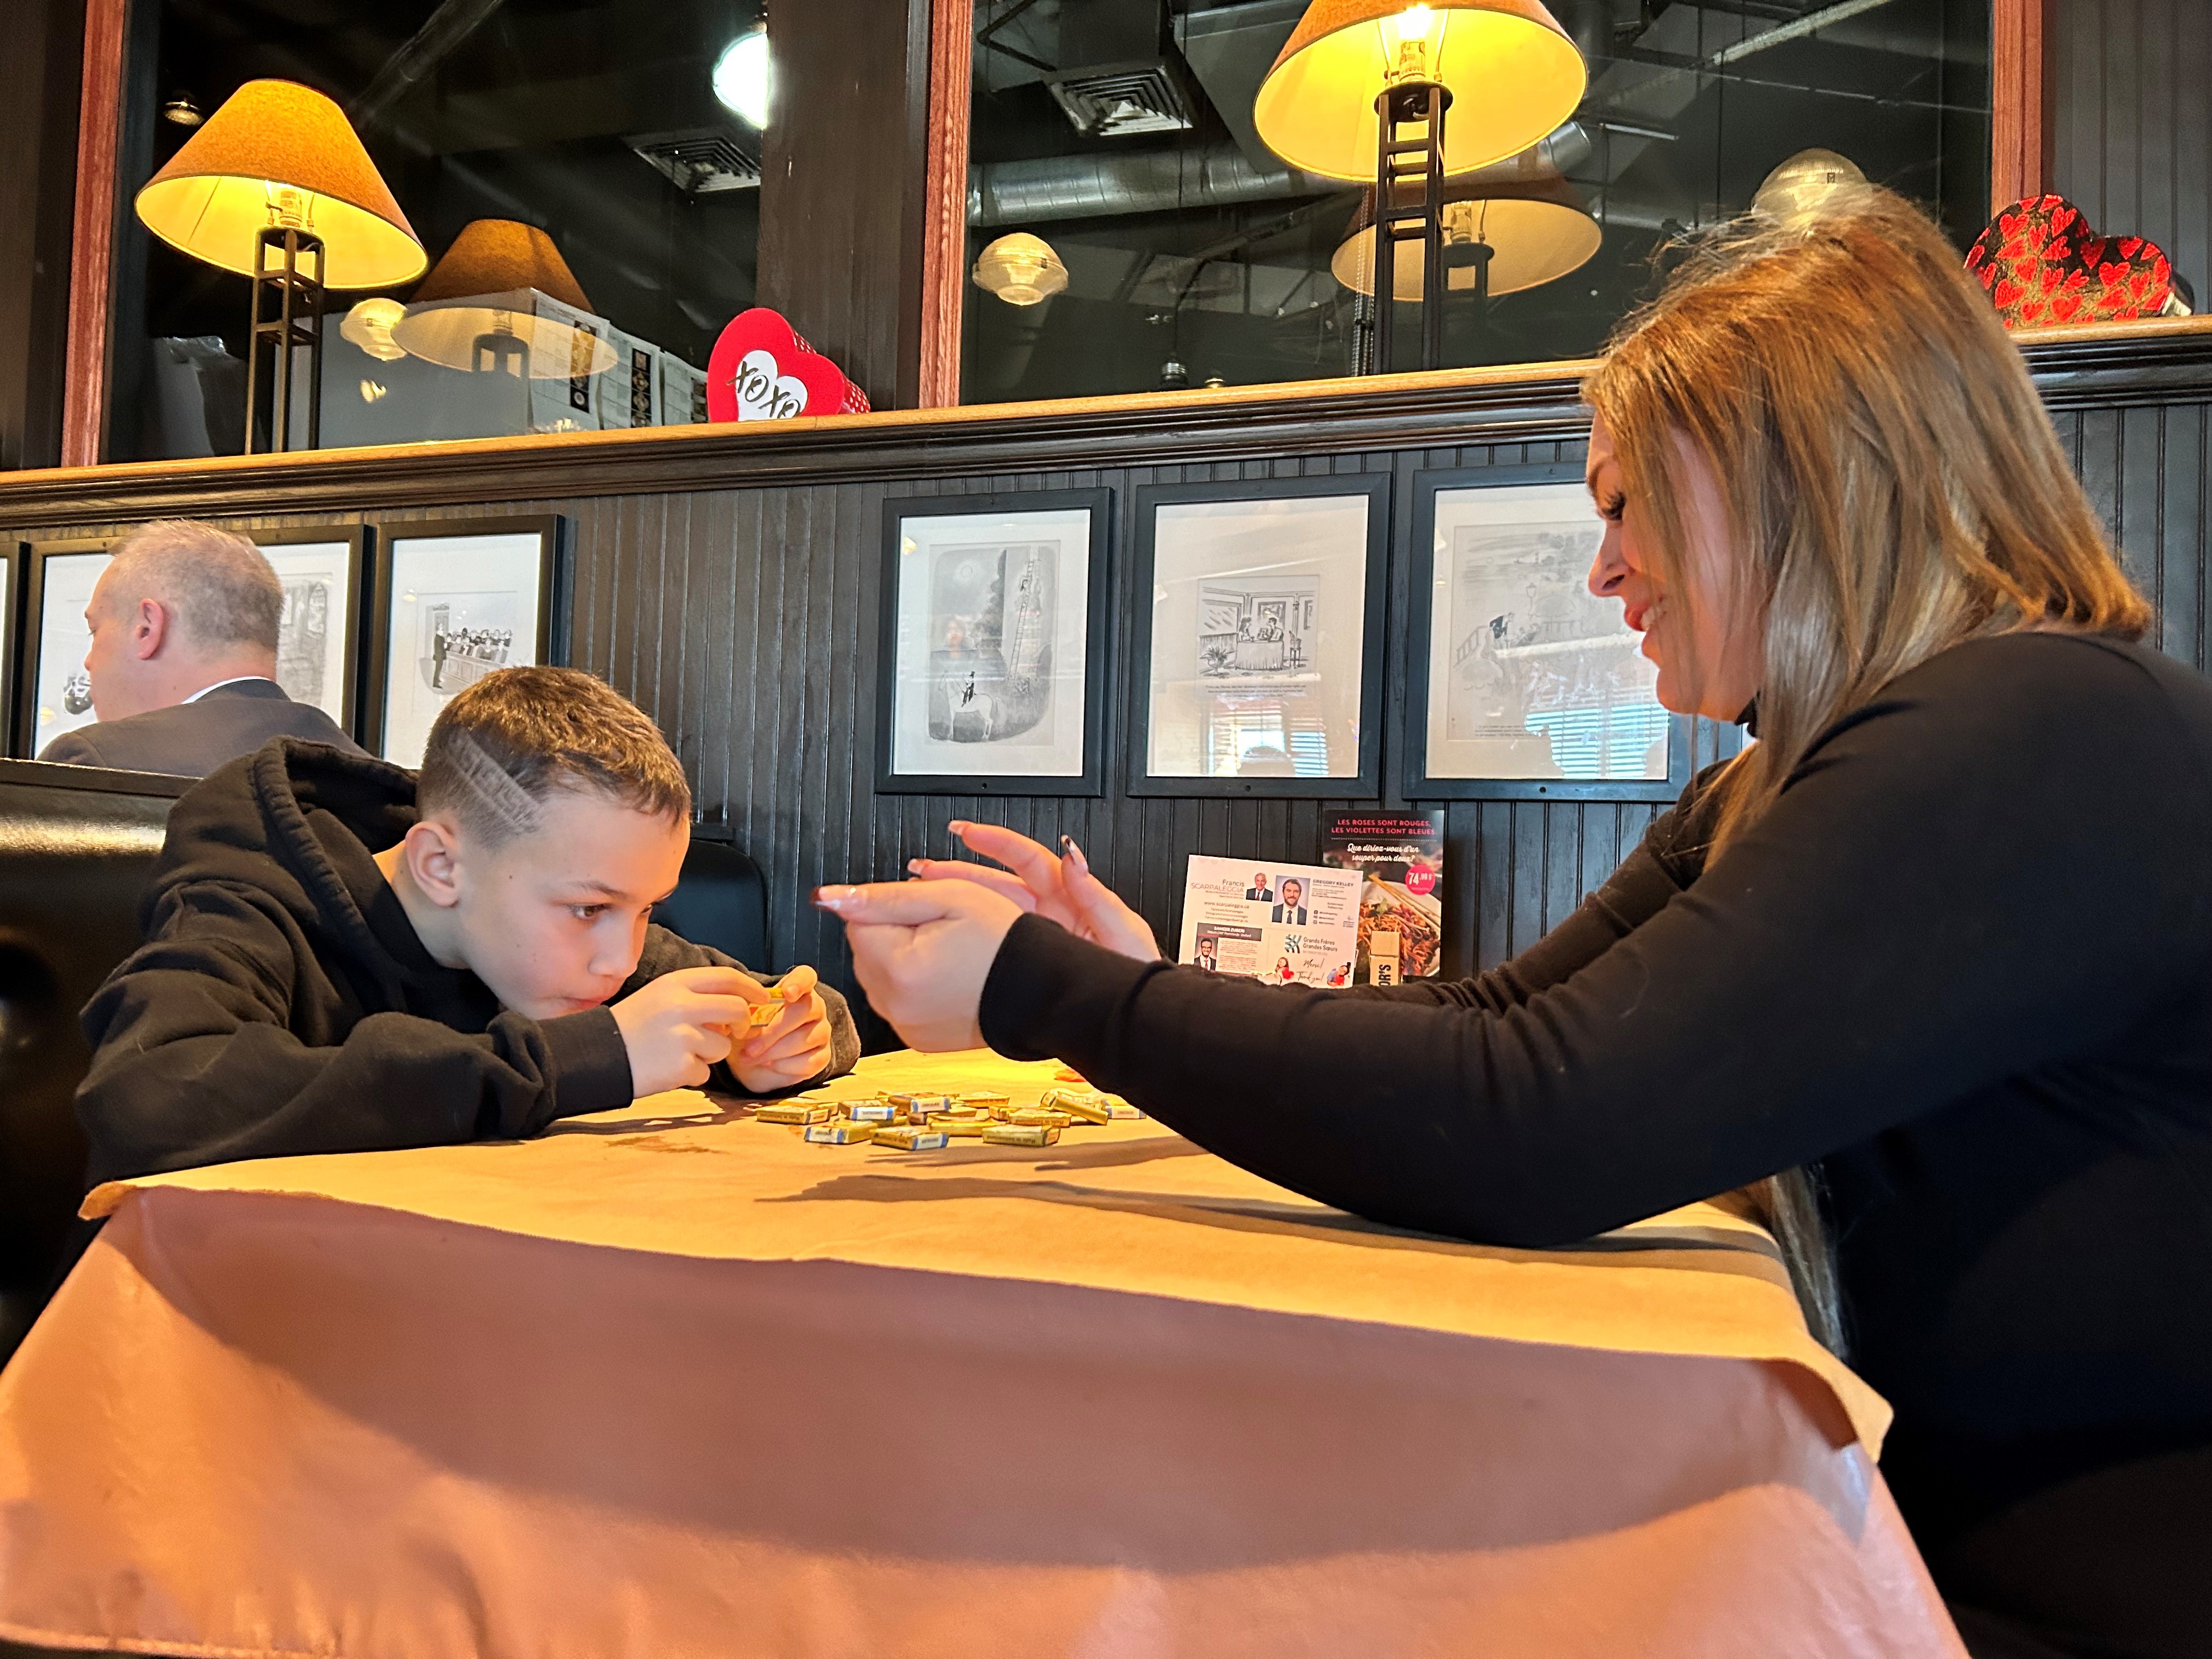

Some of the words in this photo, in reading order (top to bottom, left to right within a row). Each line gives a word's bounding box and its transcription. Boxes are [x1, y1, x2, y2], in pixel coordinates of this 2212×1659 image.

[1347, 843, 1362, 853] Que
[1362, 844, 1403, 853] diriez-vous
[1191, 883, 1244, 893] SCARPALEGGIA
